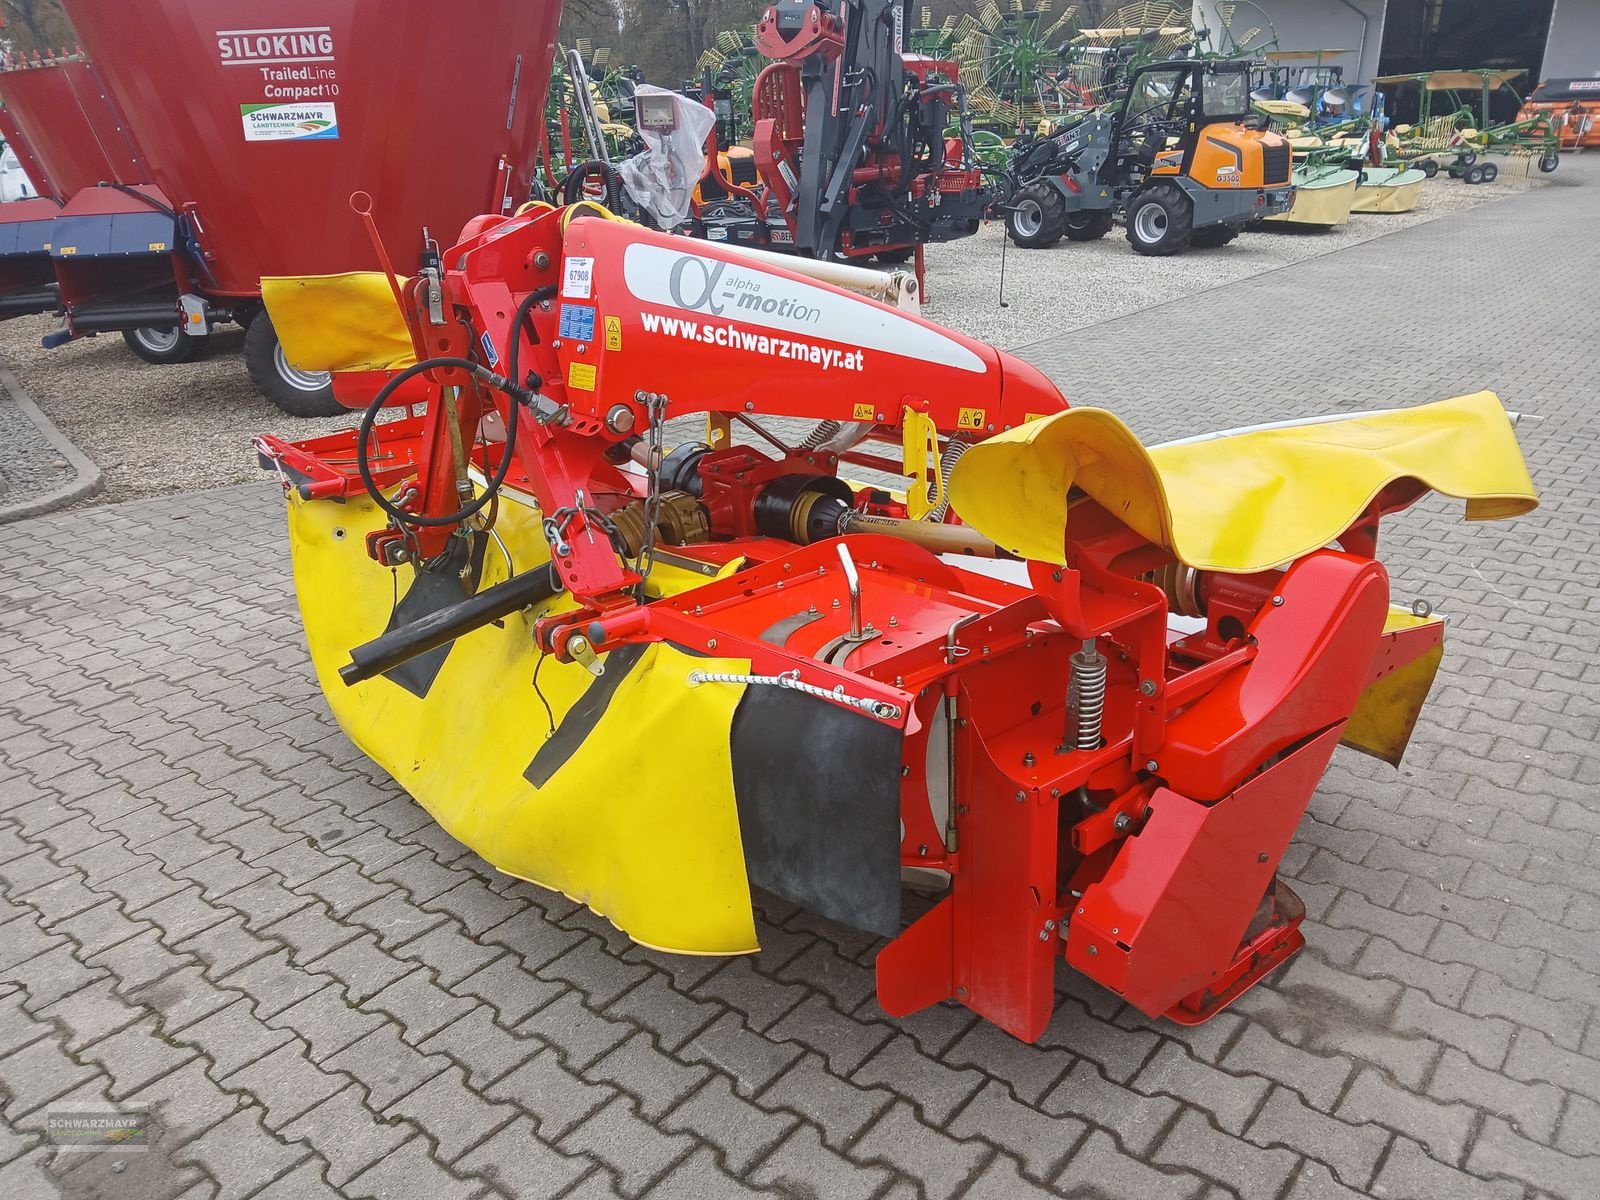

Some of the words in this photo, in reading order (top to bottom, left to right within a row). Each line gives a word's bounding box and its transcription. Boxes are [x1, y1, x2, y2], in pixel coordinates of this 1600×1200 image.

[218, 34, 333, 58] SILOKING
[260, 66, 336, 80] TrailedLine
[264, 84, 339, 100] Compact10
[250, 112, 323, 121] SCHWARZMAYR
[570, 270, 589, 281] 67908
[725, 276, 761, 293] alpha
[640, 311, 865, 372] www.schwarzmayr.at
